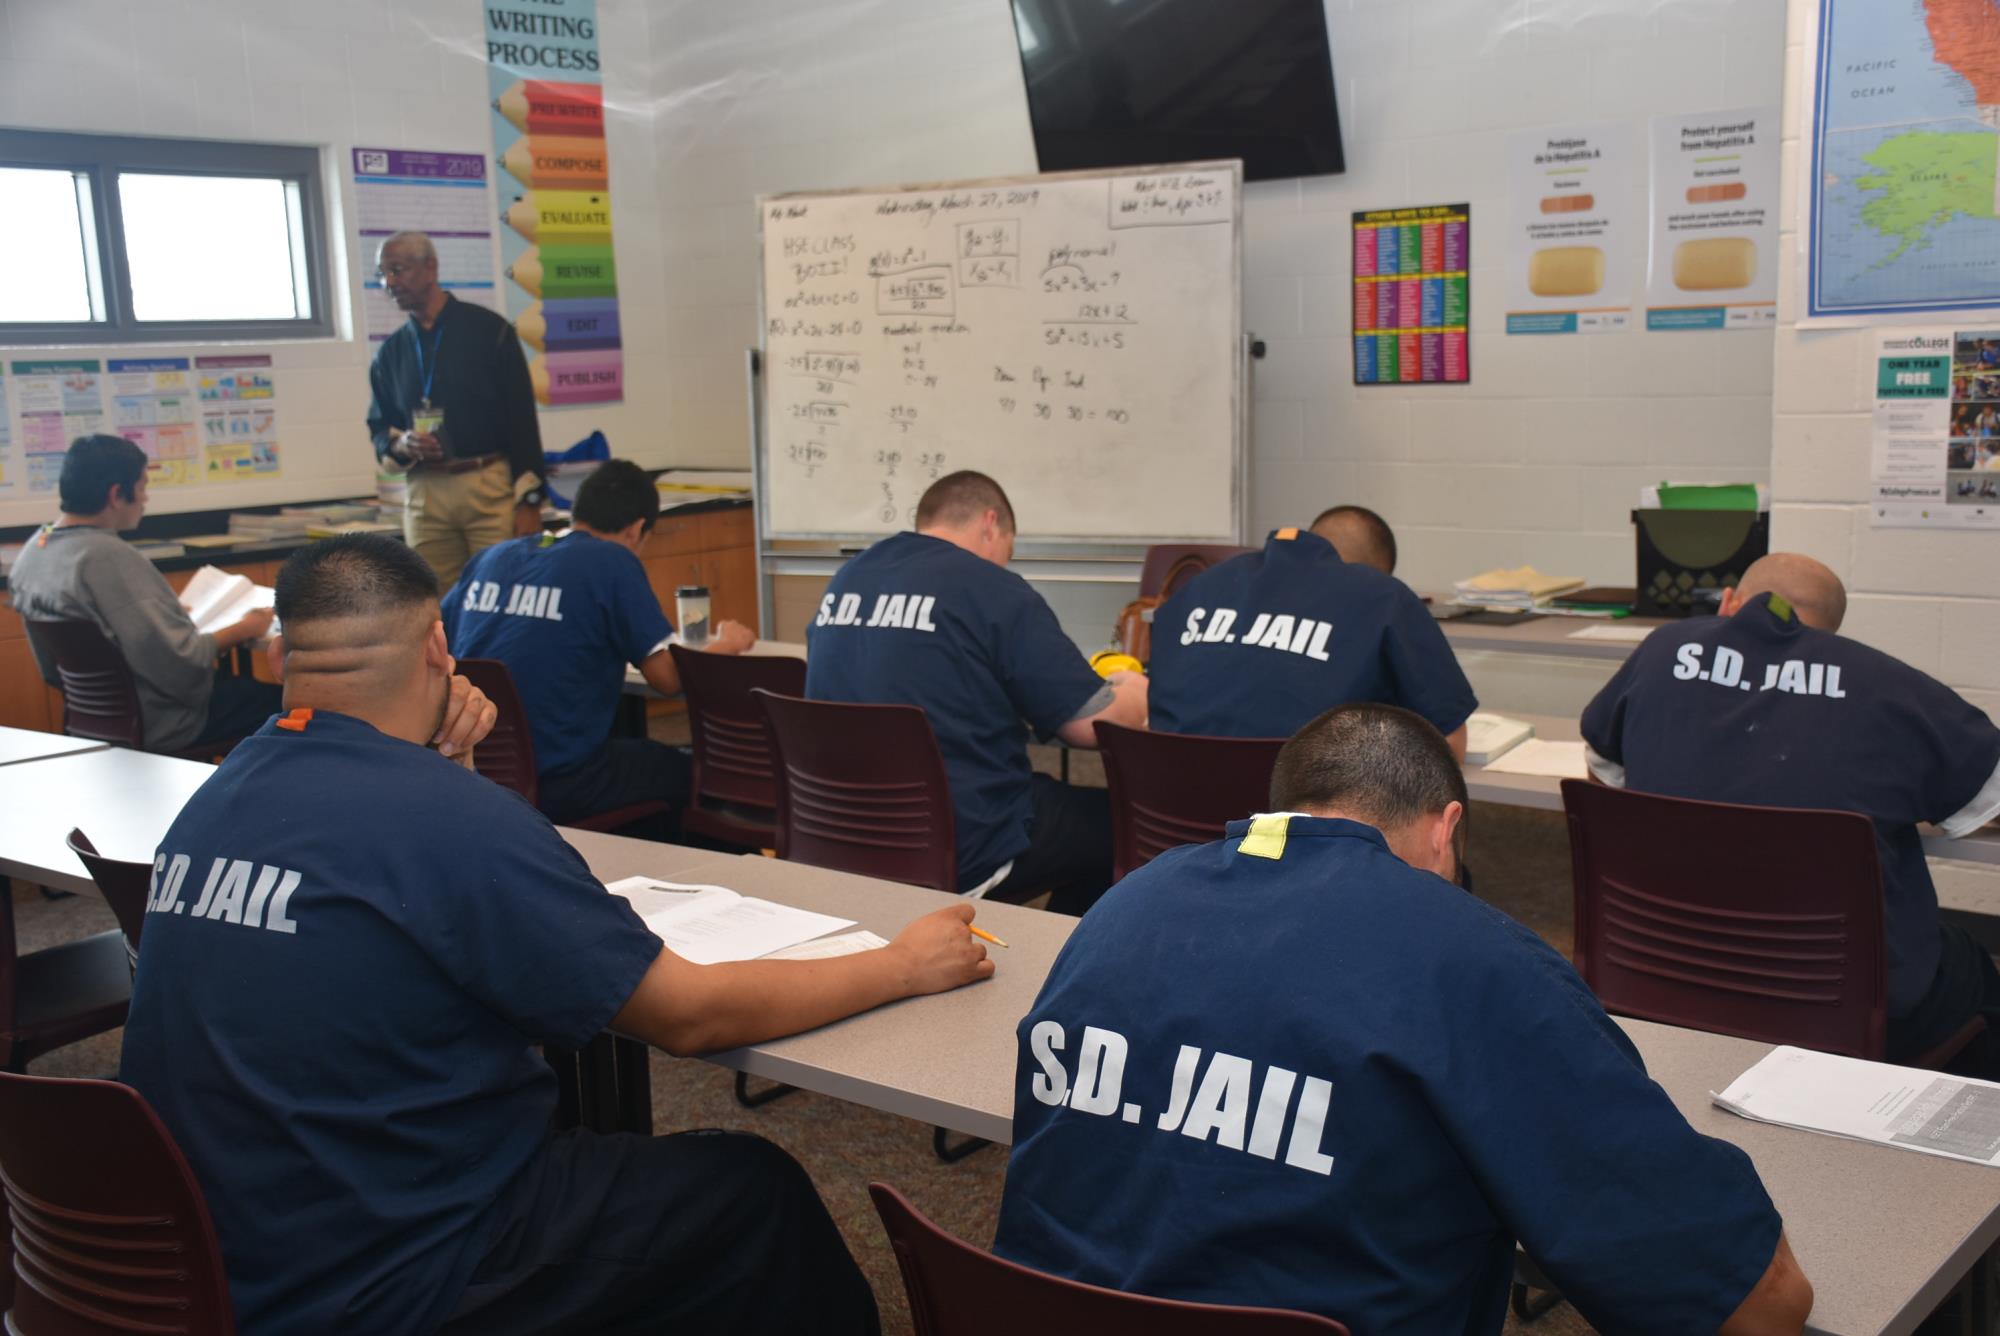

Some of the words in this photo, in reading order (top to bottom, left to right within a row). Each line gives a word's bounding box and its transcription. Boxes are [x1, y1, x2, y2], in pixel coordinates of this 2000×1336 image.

[488, 9, 594, 40] WRITING
[487, 41, 601, 72] PROCESS
[1845, 59, 1897, 73] PACIFIC
[1850, 85, 1896, 99] OCEAN
[1681, 125, 1715, 138] Protect
[1717, 120, 1755, 137] yourself
[1680, 141, 1702, 152] from
[1703, 136, 1746, 150] Hepatitis
[447, 160, 482, 176] 2019
[535, 156, 604, 171] COMPOSE
[541, 211, 609, 226] EVALUATE
[555, 265, 603, 280] REVISE
[567, 319, 599, 332] EDIT
[1907, 337, 1950, 349] COLLEGE
[1887, 360, 1909, 369] ONE
[1913, 359, 1940, 369] YEAR
[557, 369, 616, 387] PUBLISH
[1896, 371, 1931, 386] FREE
[463, 580, 501, 613] S.D.
[504, 583, 563, 622] JAIL
[815, 592, 863, 627] S.D.
[866, 593, 936, 633] JAIL
[1180, 607, 1238, 646] S.D.
[1240, 612, 1333, 662] JAIL
[1673, 642, 1751, 692] S.D.
[1759, 659, 1846, 698] JAIL
[145, 852, 191, 914] S.D.
[190, 857, 303, 934] JAIL
[1030, 1020, 1142, 1124] S.D.
[1157, 1044, 1335, 1176] JAIL
